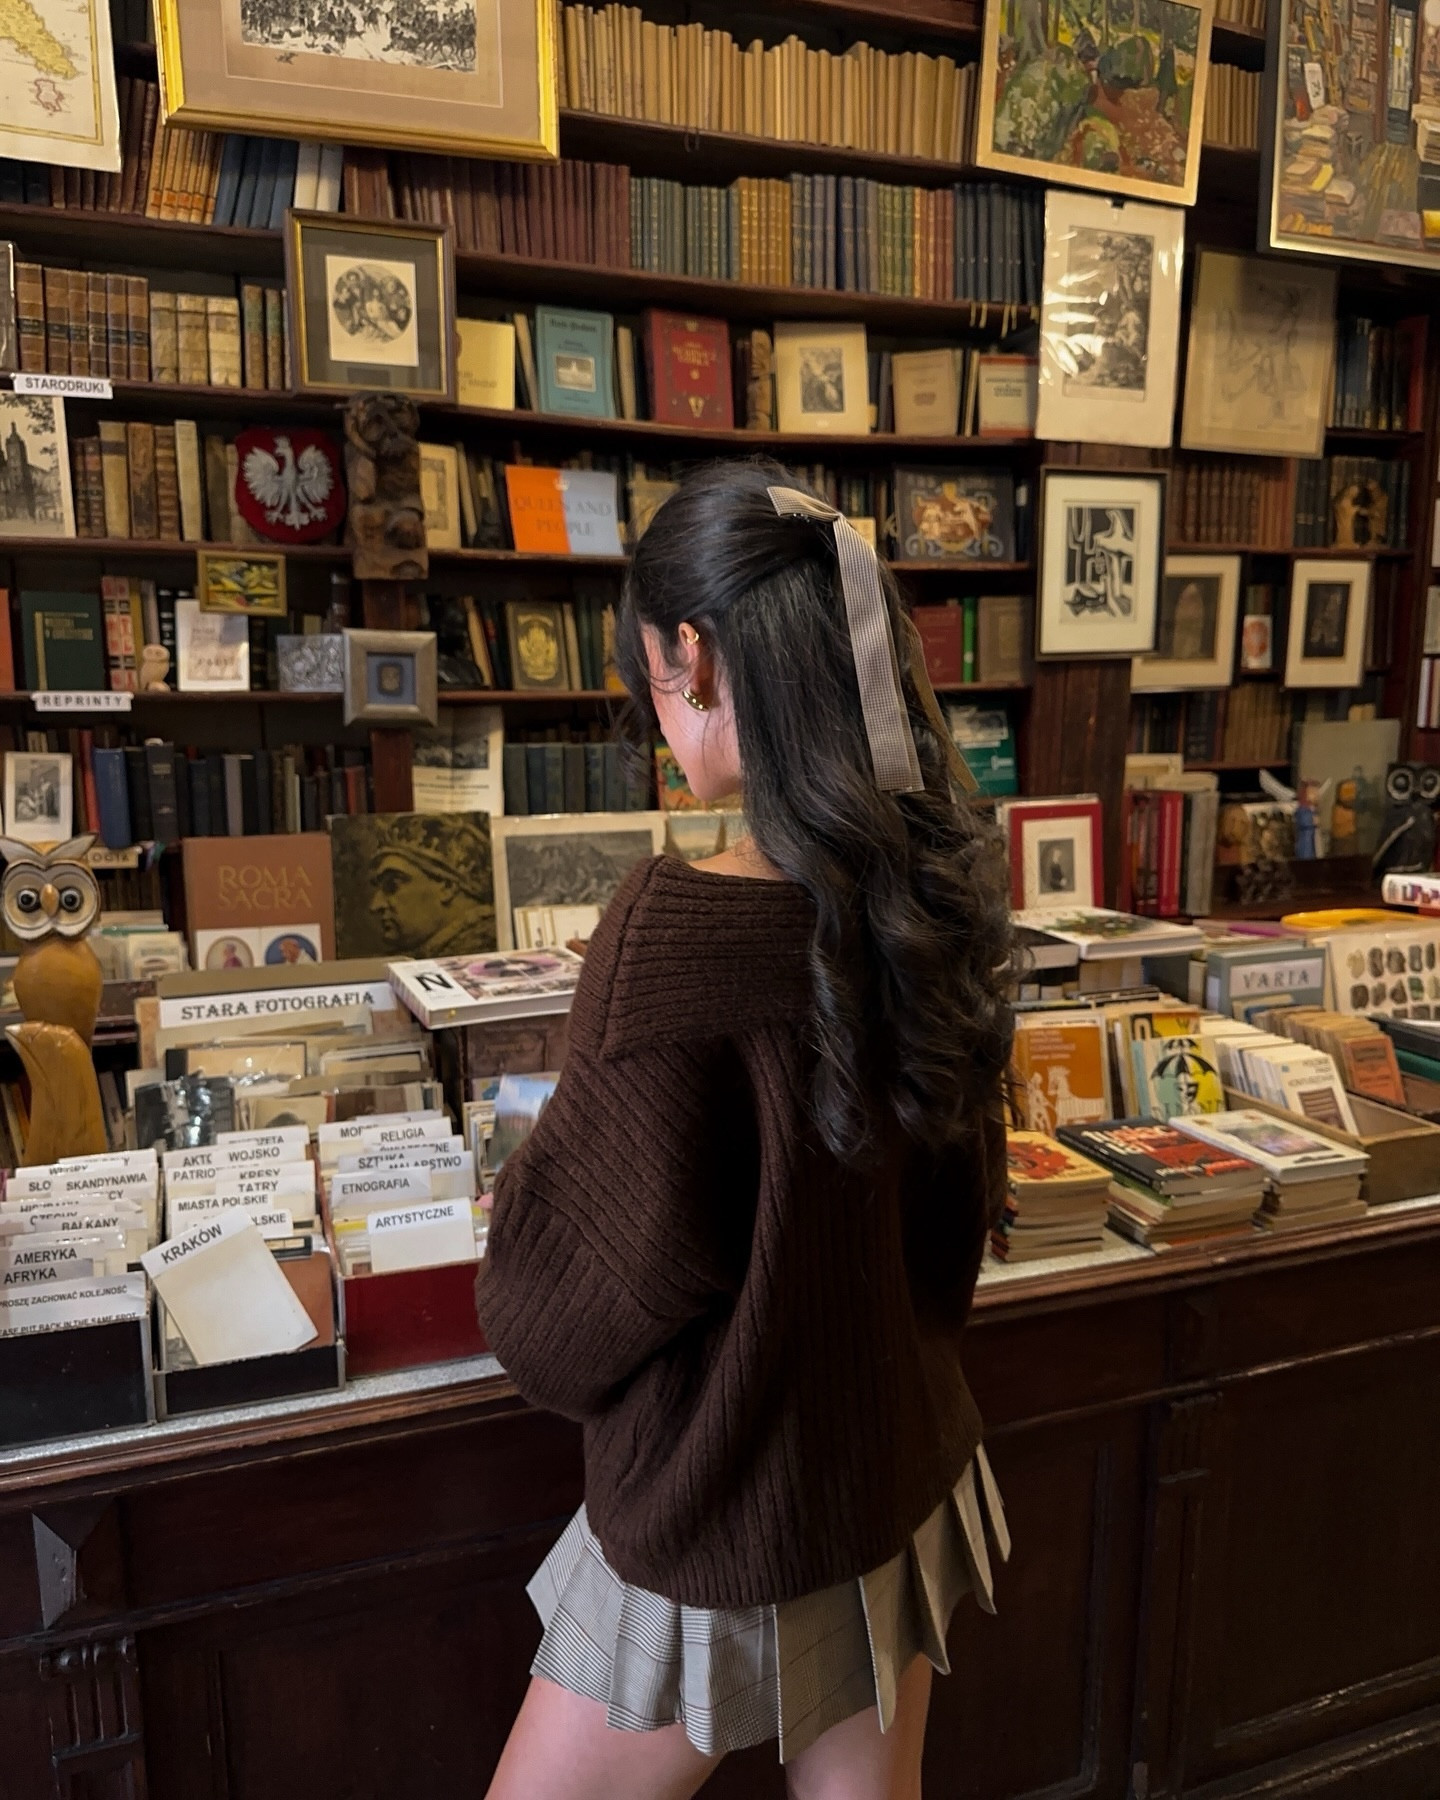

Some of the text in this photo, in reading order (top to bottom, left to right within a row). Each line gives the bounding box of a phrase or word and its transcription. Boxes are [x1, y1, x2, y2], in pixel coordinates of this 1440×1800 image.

[25, 377, 104, 393] STARODRUKI
[42, 694, 123, 706] REPRINTY
[218, 865, 313, 888] ROMA
[219, 887, 313, 909] SACRA
[1243, 969, 1310, 989] VARIA
[181, 990, 375, 1020] STARA FOTOGRAFIA
[381, 1127, 425, 1142] RELIGIA
[229, 1147, 280, 1162] WOJSKO
[66, 1173, 147, 1191] SKANDYNAWIA
[238, 1180, 279, 1192] TATRY
[342, 1178, 410, 1194] ETNOGRAFIA
[178, 1194, 268, 1211] MIASTA POLSKIE
[375, 1205, 454, 1229] ARTYSTYCZNE
[161, 1223, 223, 1264] KRAKÓW
[14, 1248, 77, 1265] AMERYKA
[4, 1267, 57, 1284] AFRYKA
[31, 1291, 78, 1305] ZACHOWAĆ
[80, 1285, 128, 1299] KOLEJNOŚĆ
